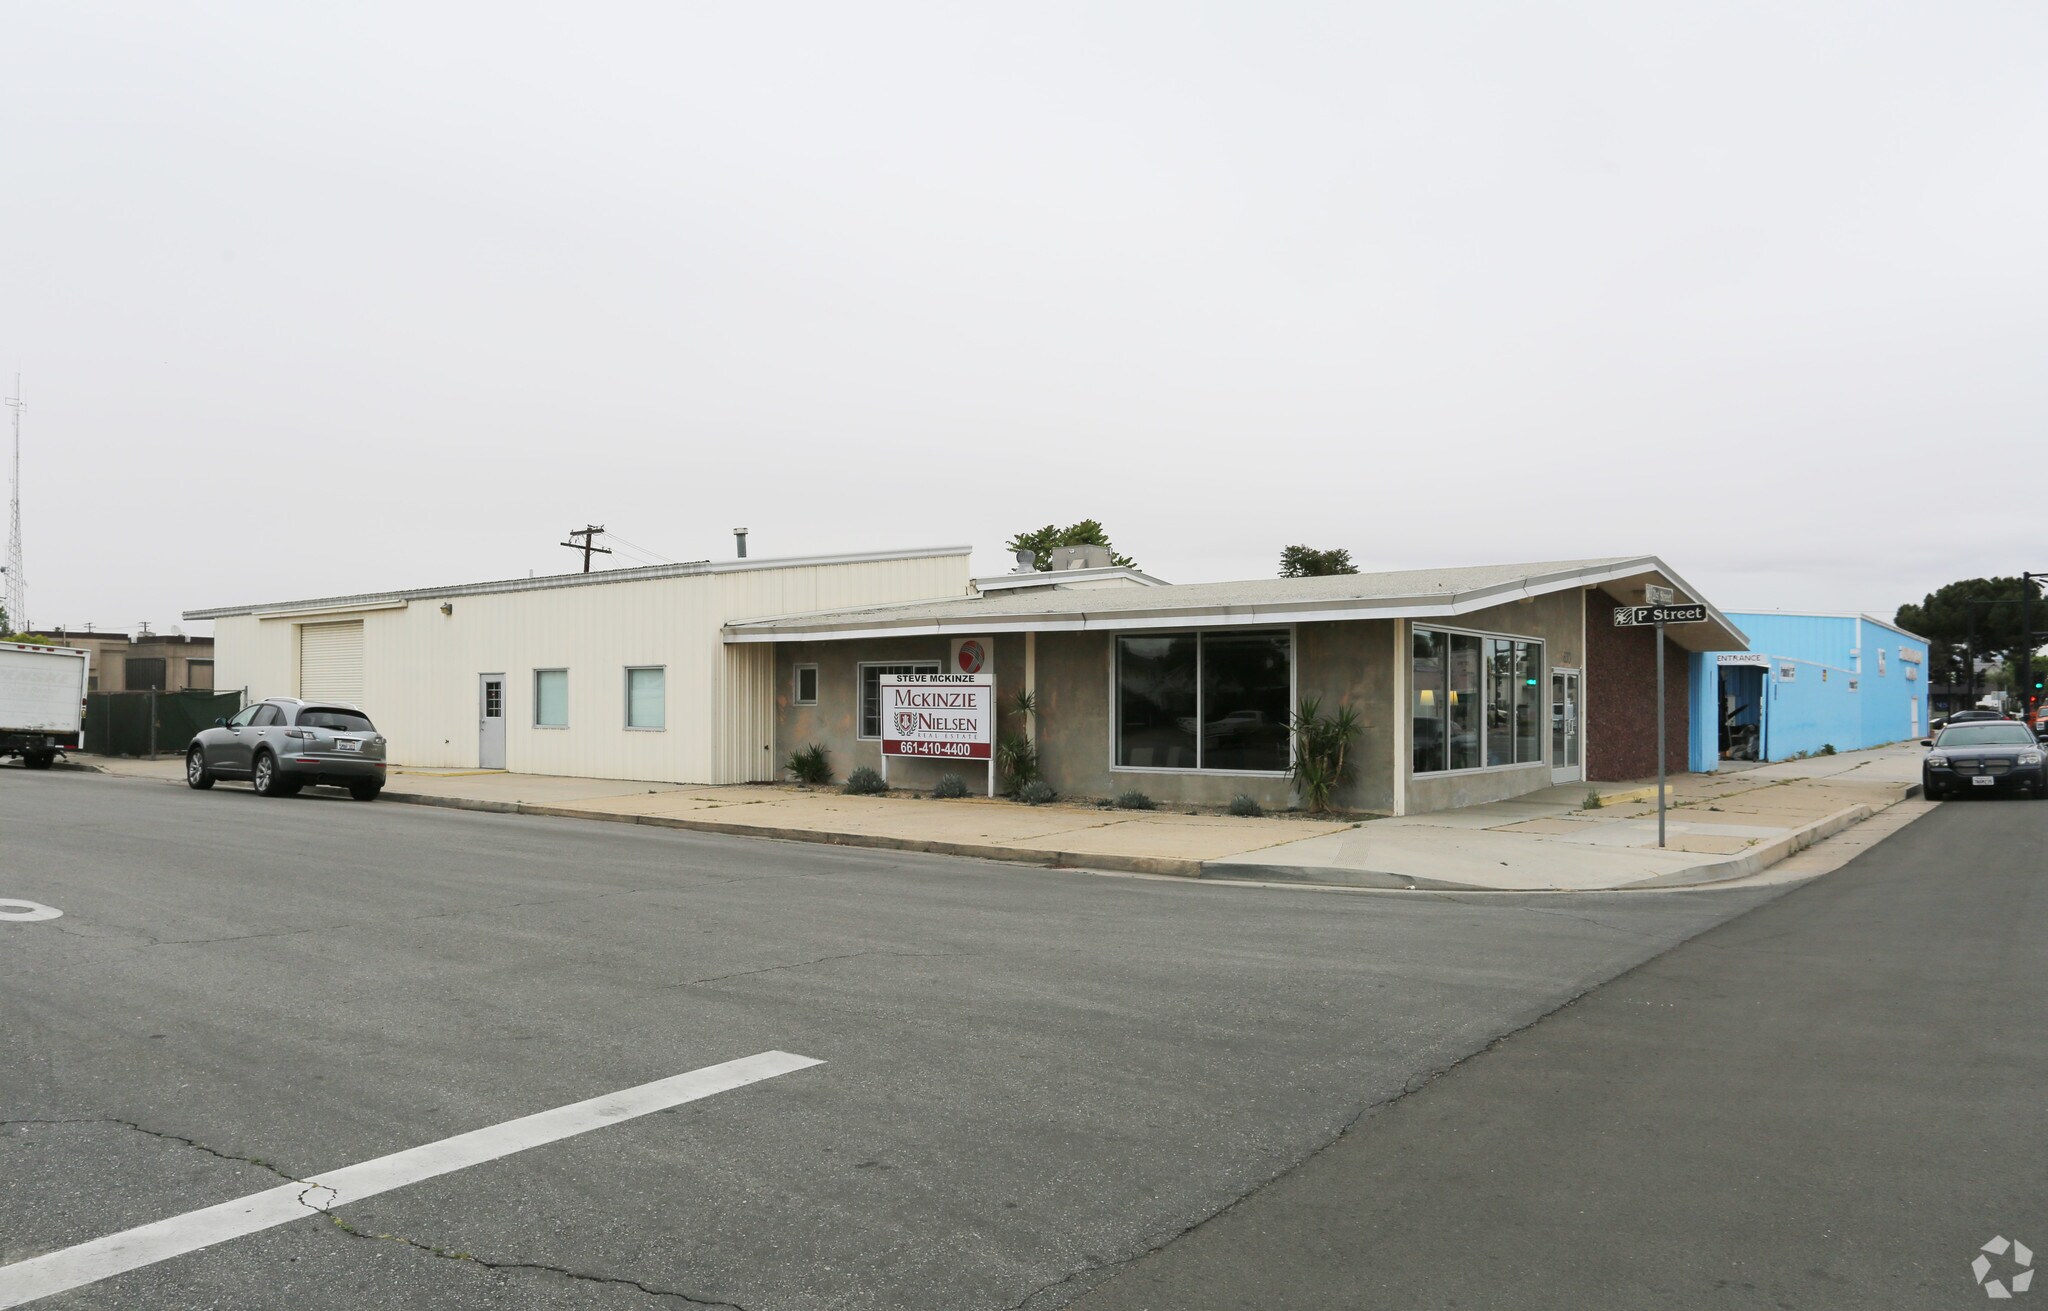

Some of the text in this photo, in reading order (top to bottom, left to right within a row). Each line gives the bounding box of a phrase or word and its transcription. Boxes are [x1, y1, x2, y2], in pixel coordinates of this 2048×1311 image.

[1653, 607, 1702, 621] Street
[1717, 654, 1761, 662] ENTRANCE
[929, 675, 975, 683] MCKINZE
[900, 742, 970, 755] 661-410-4400
